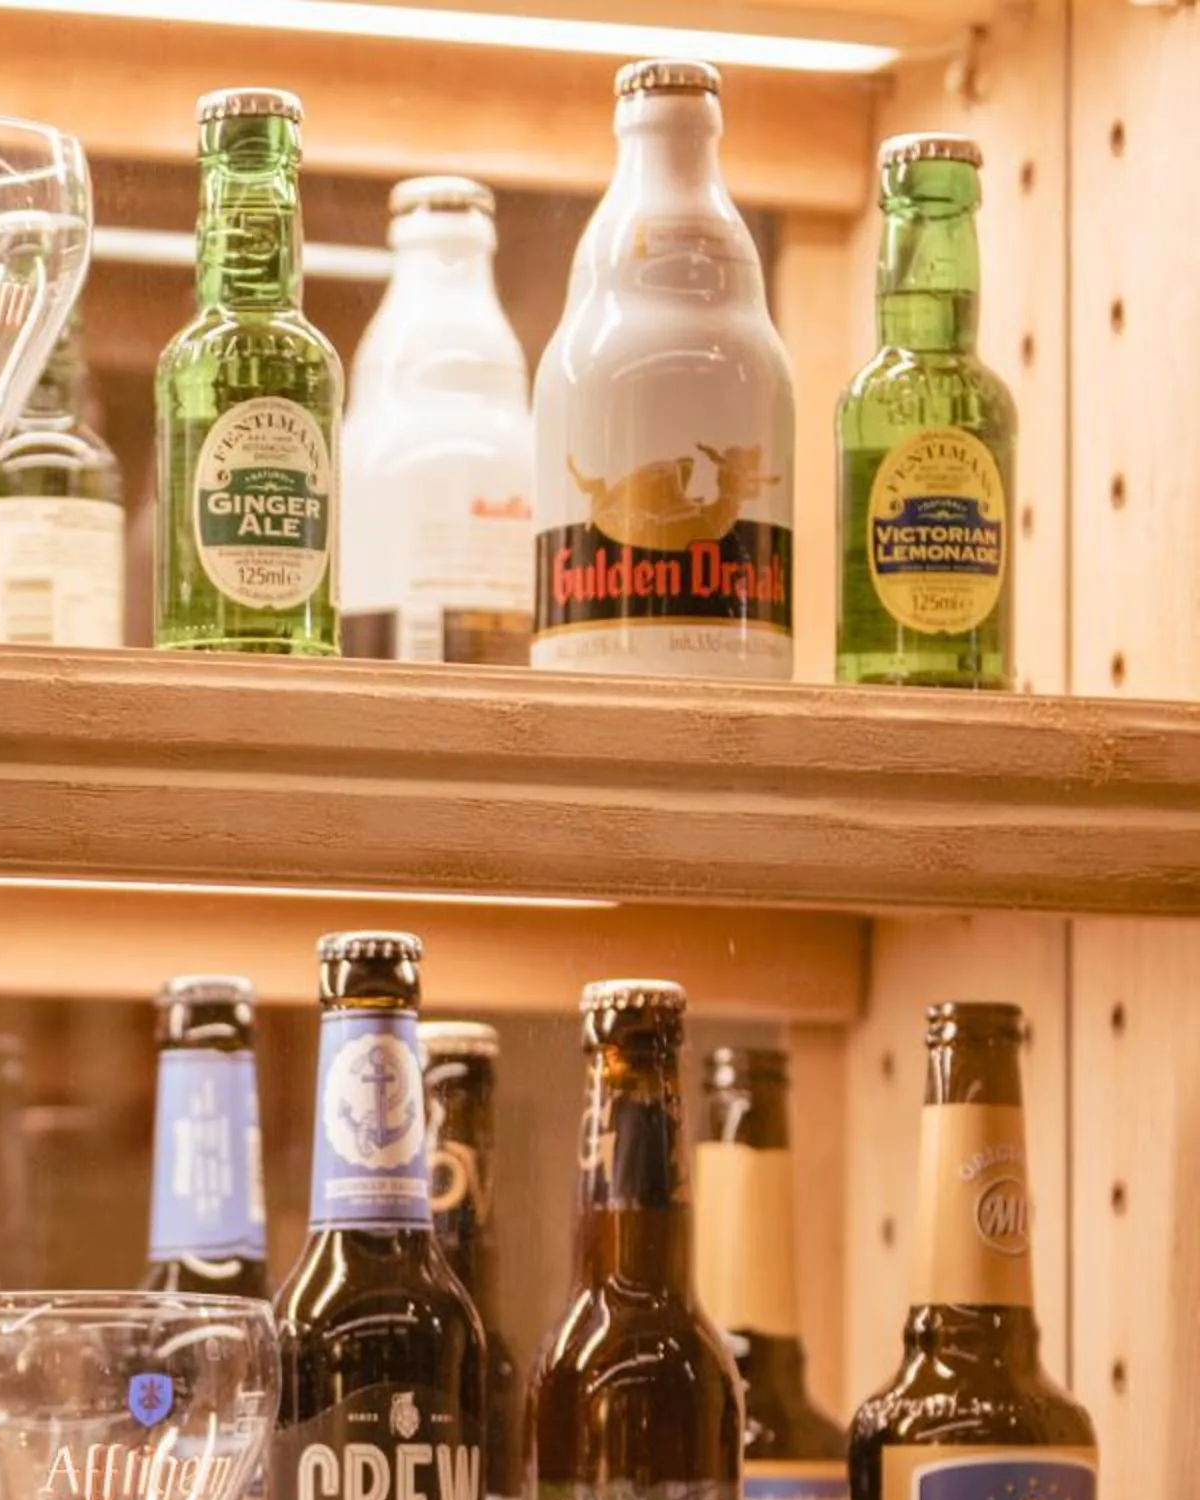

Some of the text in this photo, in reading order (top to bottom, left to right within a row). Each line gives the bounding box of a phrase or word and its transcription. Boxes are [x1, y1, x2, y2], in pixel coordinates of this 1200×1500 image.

[207, 492, 321, 519] GINGER
[237, 513, 301, 538] ALE
[876, 526, 998, 545] VICTORIAN
[877, 544, 1000, 563] LEMONADE
[238, 566, 287, 586] 125ml
[553, 539, 785, 605] Gulden Draak
